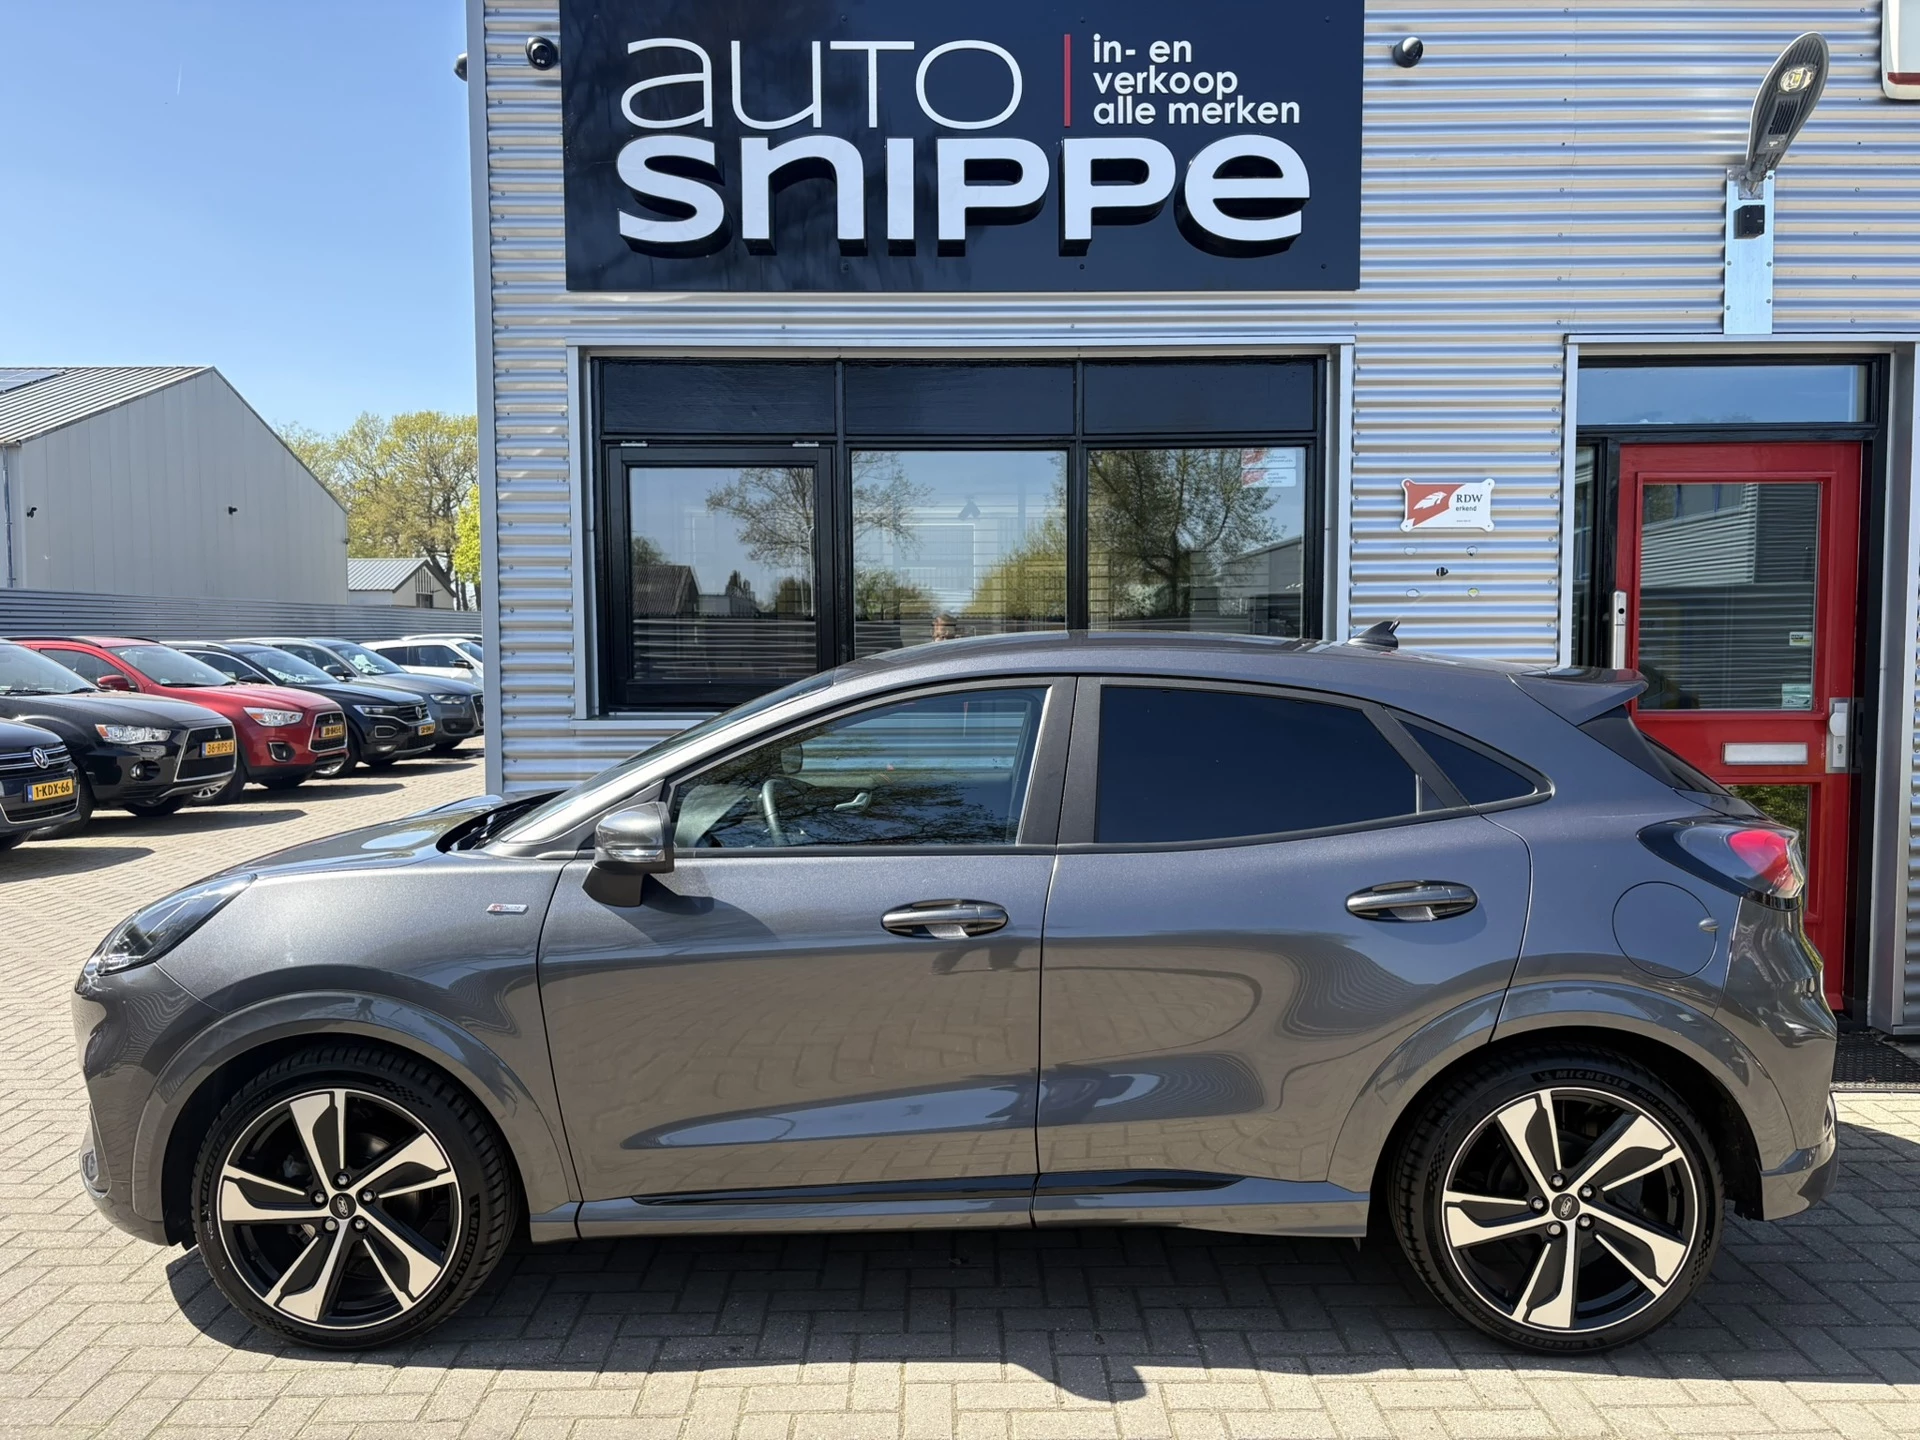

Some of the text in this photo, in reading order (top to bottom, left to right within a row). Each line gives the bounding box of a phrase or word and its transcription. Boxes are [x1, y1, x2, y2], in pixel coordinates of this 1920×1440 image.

[1093, 33, 1192, 63] in- en
[1093, 65, 1238, 101] verkoop
[1093, 95, 1300, 124] alle merken
[1456, 494, 1483, 503] RDW
[35, 781, 71, 798] 1-KDX-66
[1554, 1069, 1631, 1090] MICHELIN
[448, 1216, 479, 1285] MICHELIN
